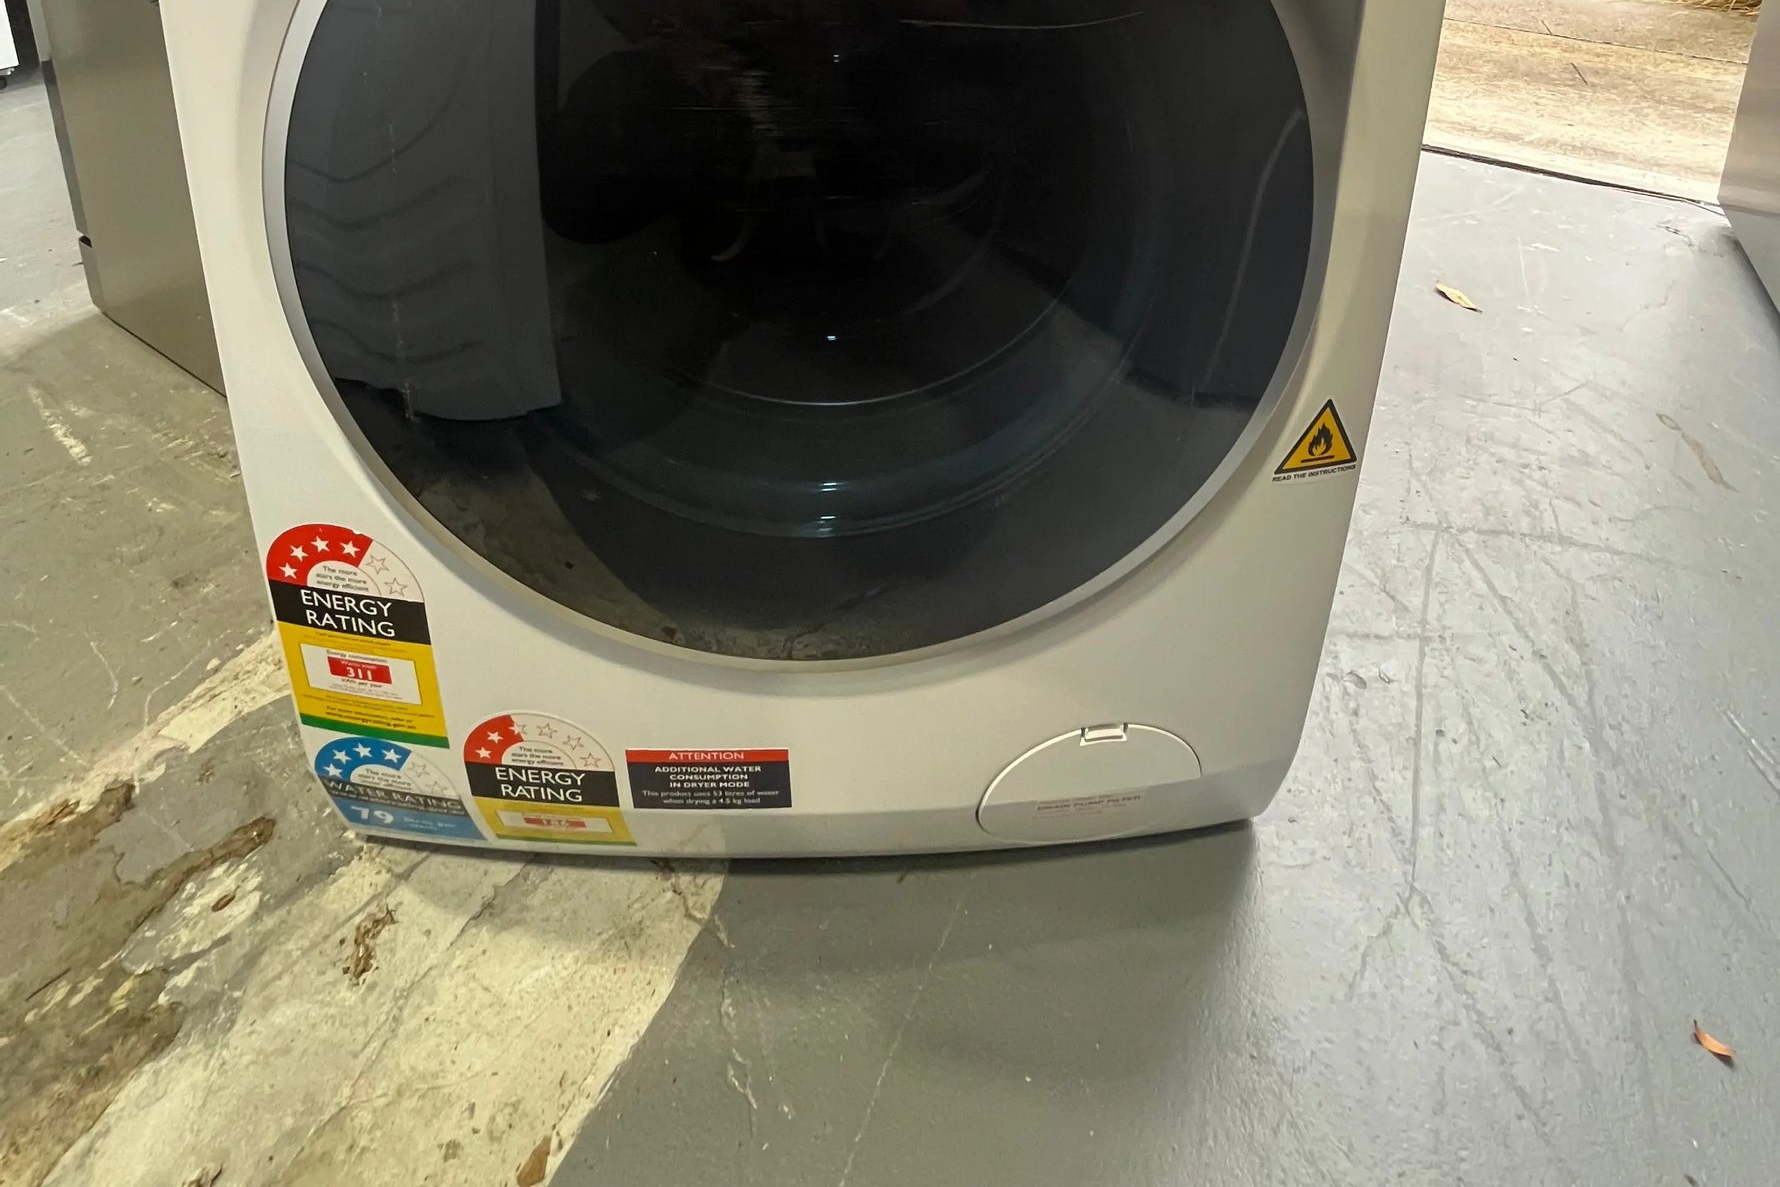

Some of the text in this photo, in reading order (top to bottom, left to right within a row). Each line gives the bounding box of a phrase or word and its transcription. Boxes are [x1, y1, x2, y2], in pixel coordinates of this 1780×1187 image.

[1272, 464, 1356, 483] READ THE INSTRUCTIONS
[322, 565, 336, 573] The
[300, 589, 392, 617] ENERGY
[306, 610, 395, 637] RATING
[346, 667, 373, 681] 311
[668, 752, 745, 760] ATTENTION
[495, 766, 586, 786] ENERGY
[322, 777, 389, 798] WATER
[391, 791, 462, 809] RATING
[500, 784, 583, 802] RATING
[660, 790, 691, 798] product
[350, 805, 395, 824] 79
